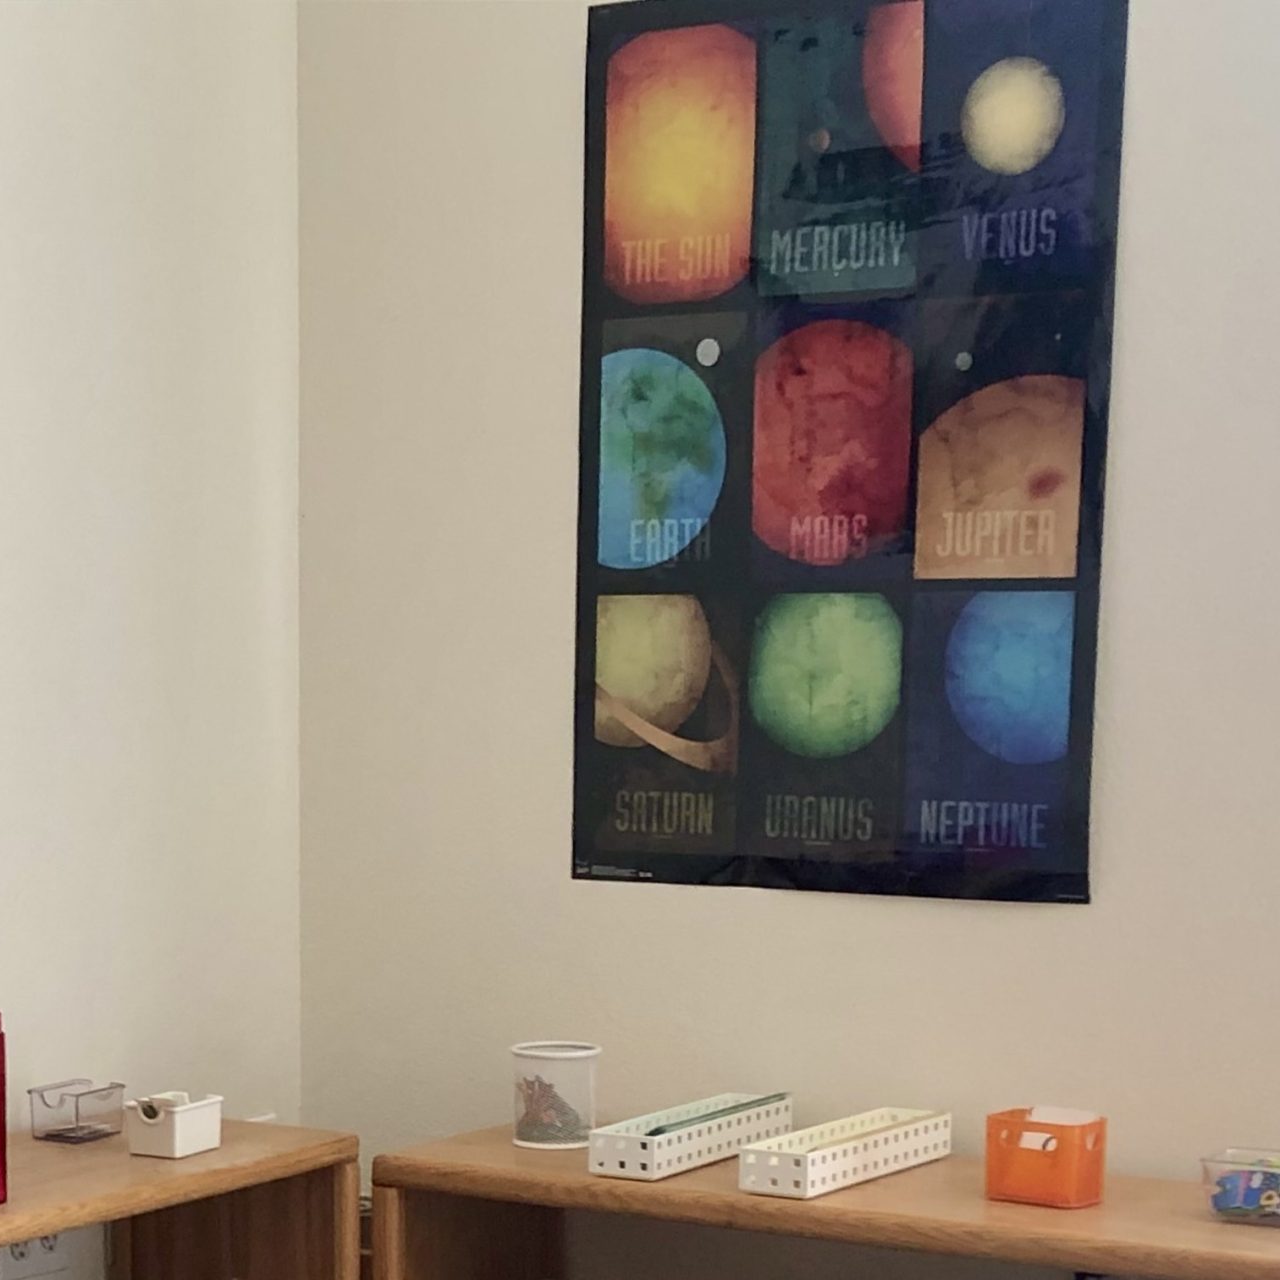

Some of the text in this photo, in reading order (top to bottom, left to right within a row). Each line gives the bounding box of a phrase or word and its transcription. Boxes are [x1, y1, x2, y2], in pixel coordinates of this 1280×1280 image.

[770, 220, 907, 275] MERCURY
[962, 207, 1058, 261] VENUS
[621, 233, 732, 285] THE SUN
[630, 516, 711, 563] EARTH
[790, 514, 868, 560] MARS
[936, 507, 1056, 558] JUPITER
[615, 791, 714, 835] SATURN
[765, 794, 873, 840] URANUS
[920, 800, 1047, 849] NEPTUNE
